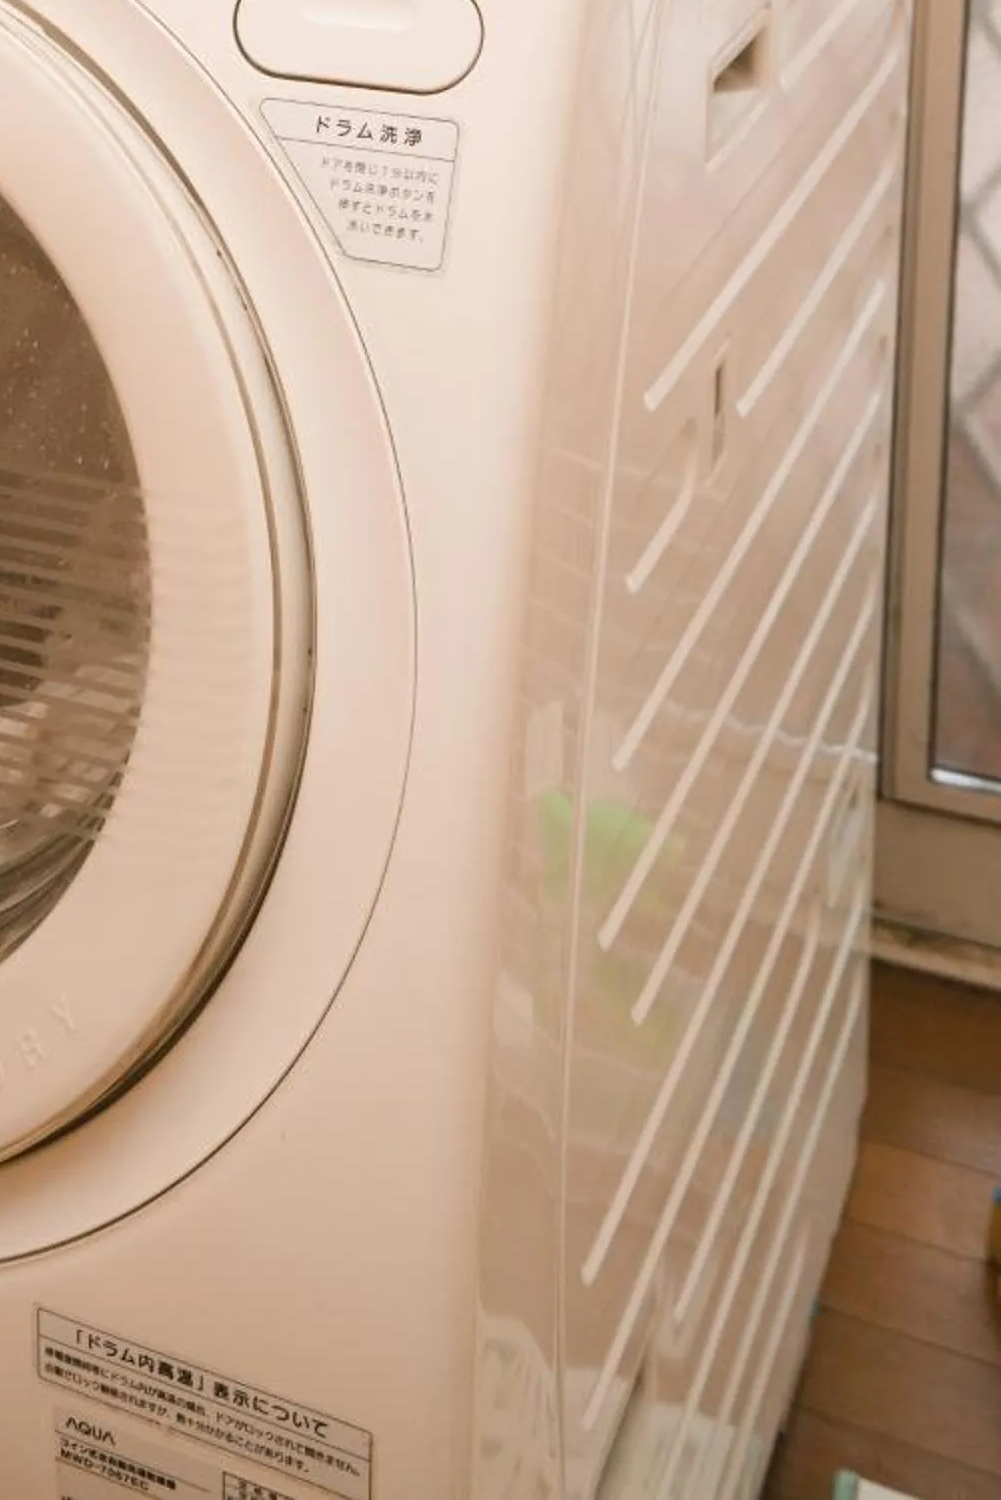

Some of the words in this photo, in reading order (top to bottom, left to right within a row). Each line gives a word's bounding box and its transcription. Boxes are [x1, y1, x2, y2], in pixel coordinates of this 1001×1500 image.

[315, 115, 423, 148] ドラム洗浄
[65, 1415, 118, 1447] AQUA
